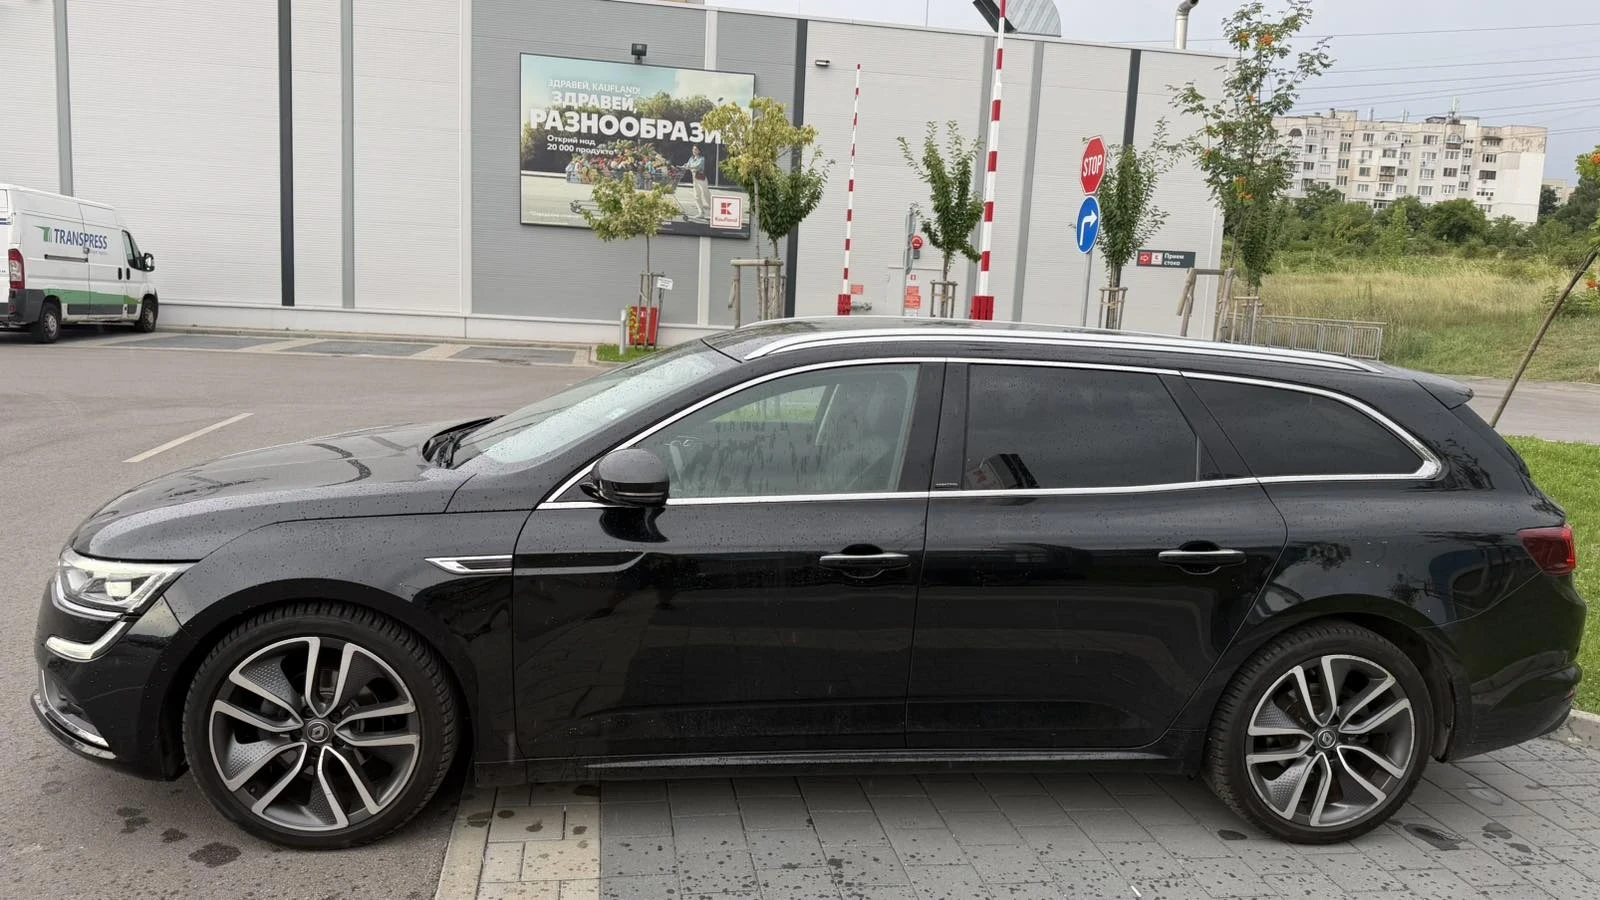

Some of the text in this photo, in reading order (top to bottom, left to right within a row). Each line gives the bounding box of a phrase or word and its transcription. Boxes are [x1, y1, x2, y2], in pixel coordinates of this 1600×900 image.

[548, 79, 641, 95] ЗДРАВЕЙ, KAUFLAND!
[552, 90, 637, 114] ЗДРАВЕЙ,
[529, 108, 727, 144] РАЗНООБРАЗИ
[547, 134, 578, 144] Открий
[547, 143, 557, 151] 20
[559, 144, 574, 152] 000
[1083, 154, 1102, 177] STOP
[54, 228, 108, 249] TRANSPRESS
